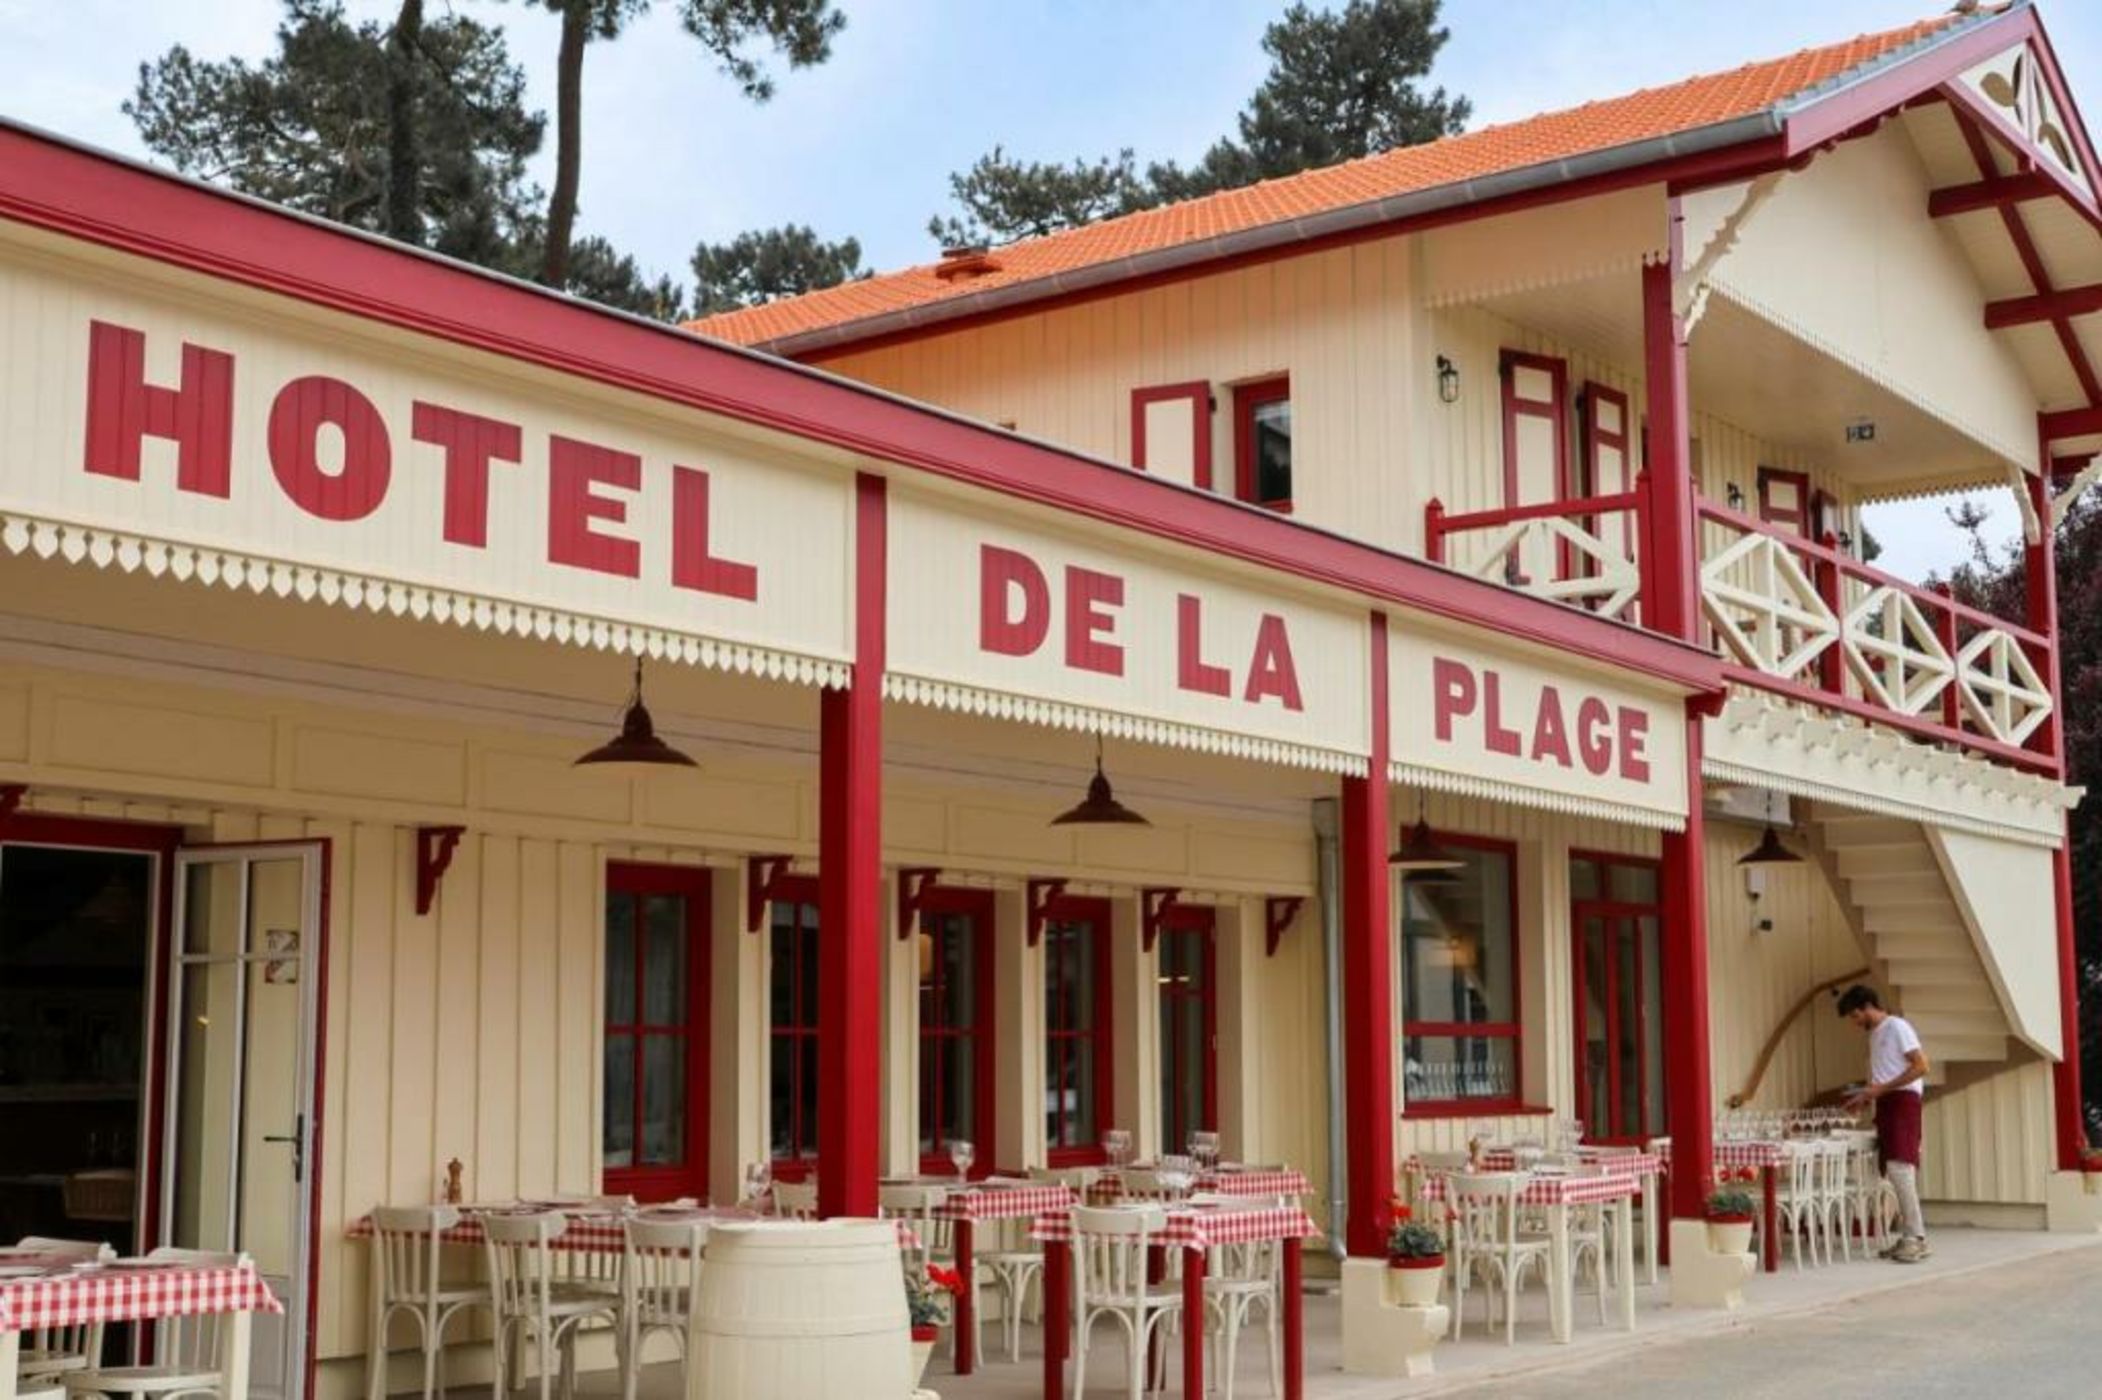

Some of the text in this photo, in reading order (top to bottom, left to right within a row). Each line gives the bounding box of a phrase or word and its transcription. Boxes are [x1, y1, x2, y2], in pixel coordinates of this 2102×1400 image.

[84, 320, 1650, 782] HOTEL DE LA PLAGE
